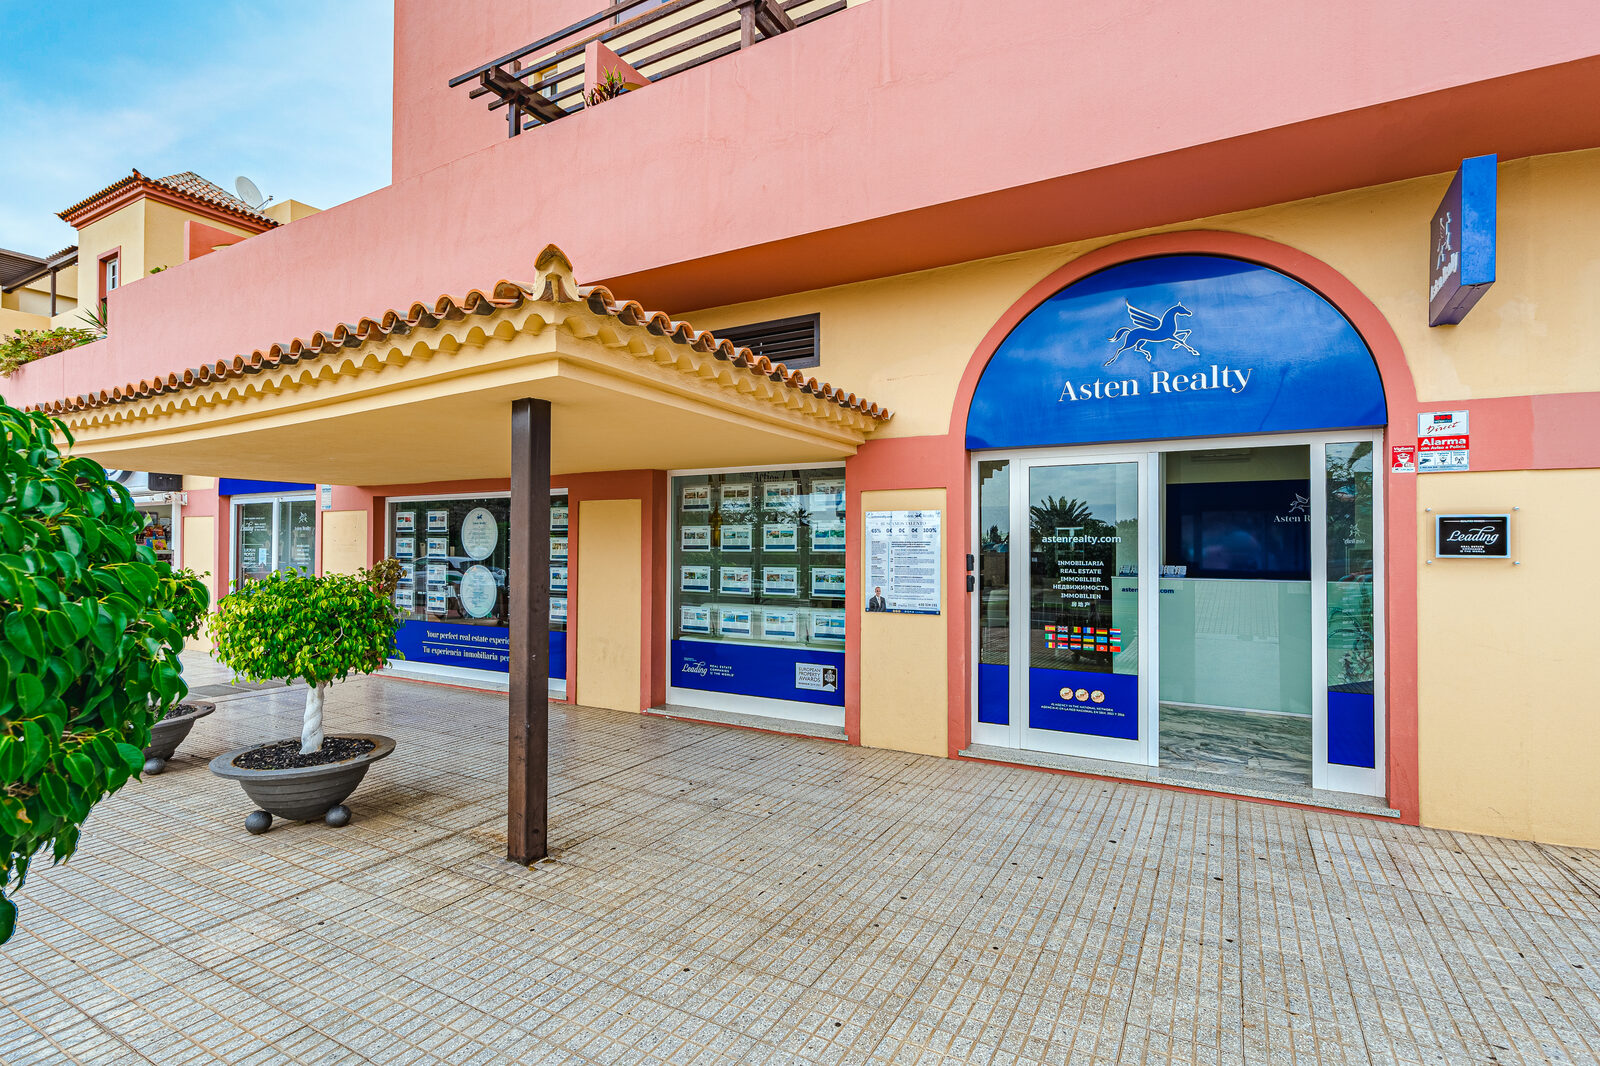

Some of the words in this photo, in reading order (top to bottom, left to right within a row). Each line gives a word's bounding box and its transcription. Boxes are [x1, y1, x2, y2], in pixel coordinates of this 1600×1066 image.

[1058, 378, 1140, 402] Asten
[1150, 364, 1253, 395] Realty
[1426, 421, 1460, 434] Direct
[1421, 438, 1466, 446] Alarma
[1273, 515, 1301, 523] Asten
[1042, 535, 1121, 544] astenrealty.com
[1446, 525, 1500, 545] Leading
[427, 630, 439, 638] Your
[440, 632, 458, 640] perfect
[431, 648, 461, 656] experiencia
[463, 650, 498, 660] inmobiliaria
[681, 661, 707, 677] Leading
